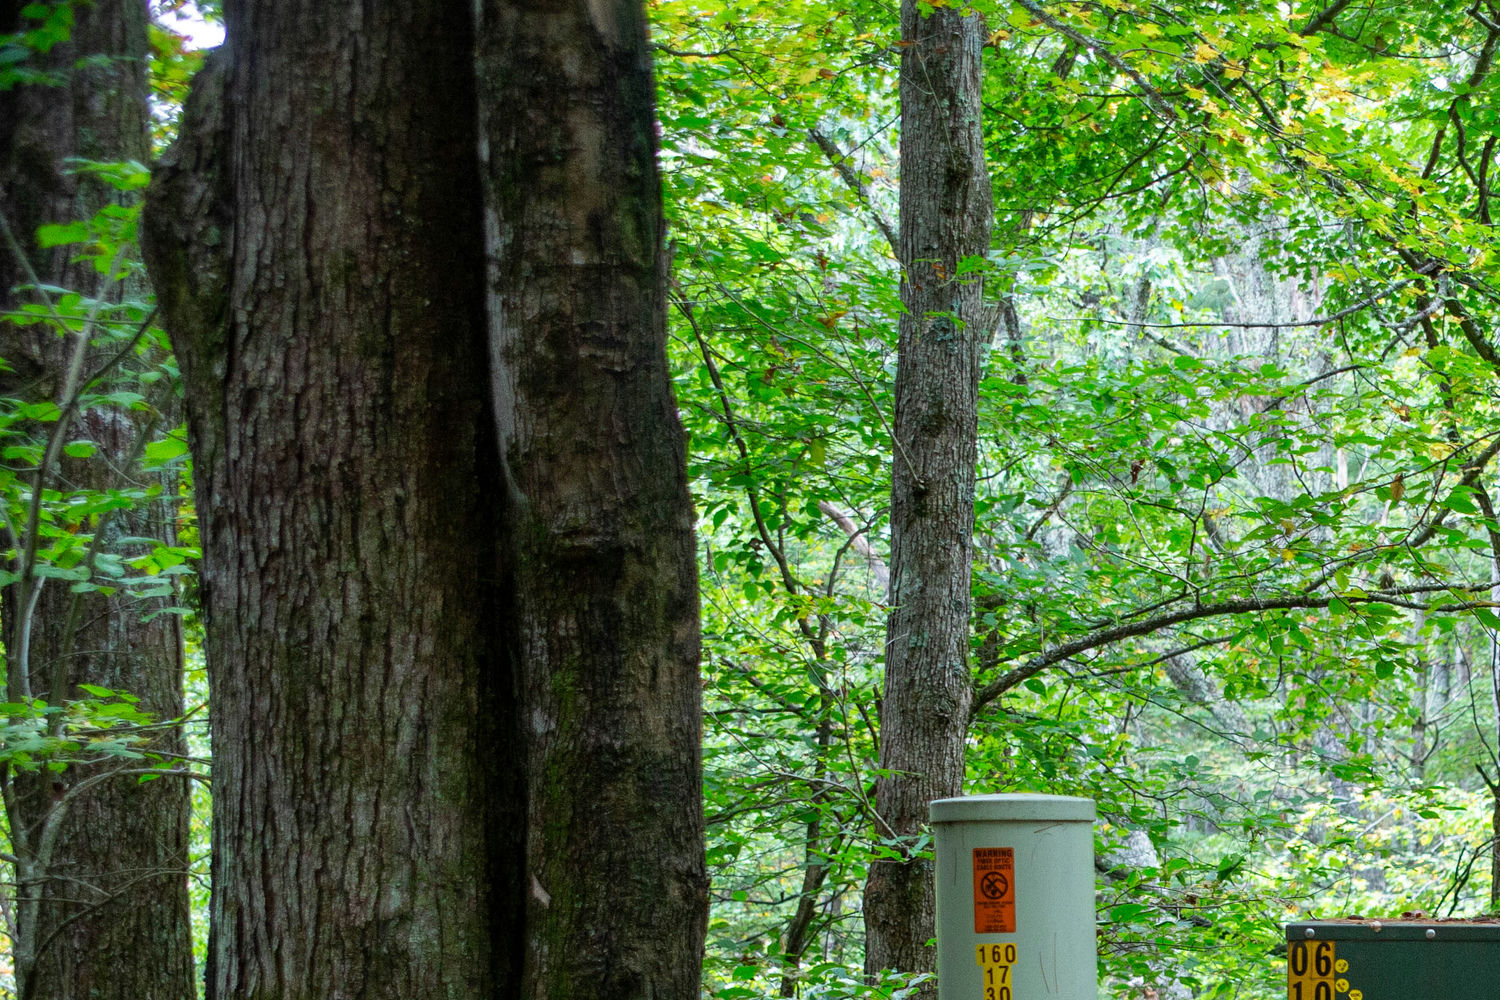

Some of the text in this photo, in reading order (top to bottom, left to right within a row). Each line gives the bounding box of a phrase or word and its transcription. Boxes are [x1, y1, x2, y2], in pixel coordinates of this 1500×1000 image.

[979, 944, 1016, 963] 160
[1291, 941, 1331, 977] 06
[986, 965, 1009, 984] 17
